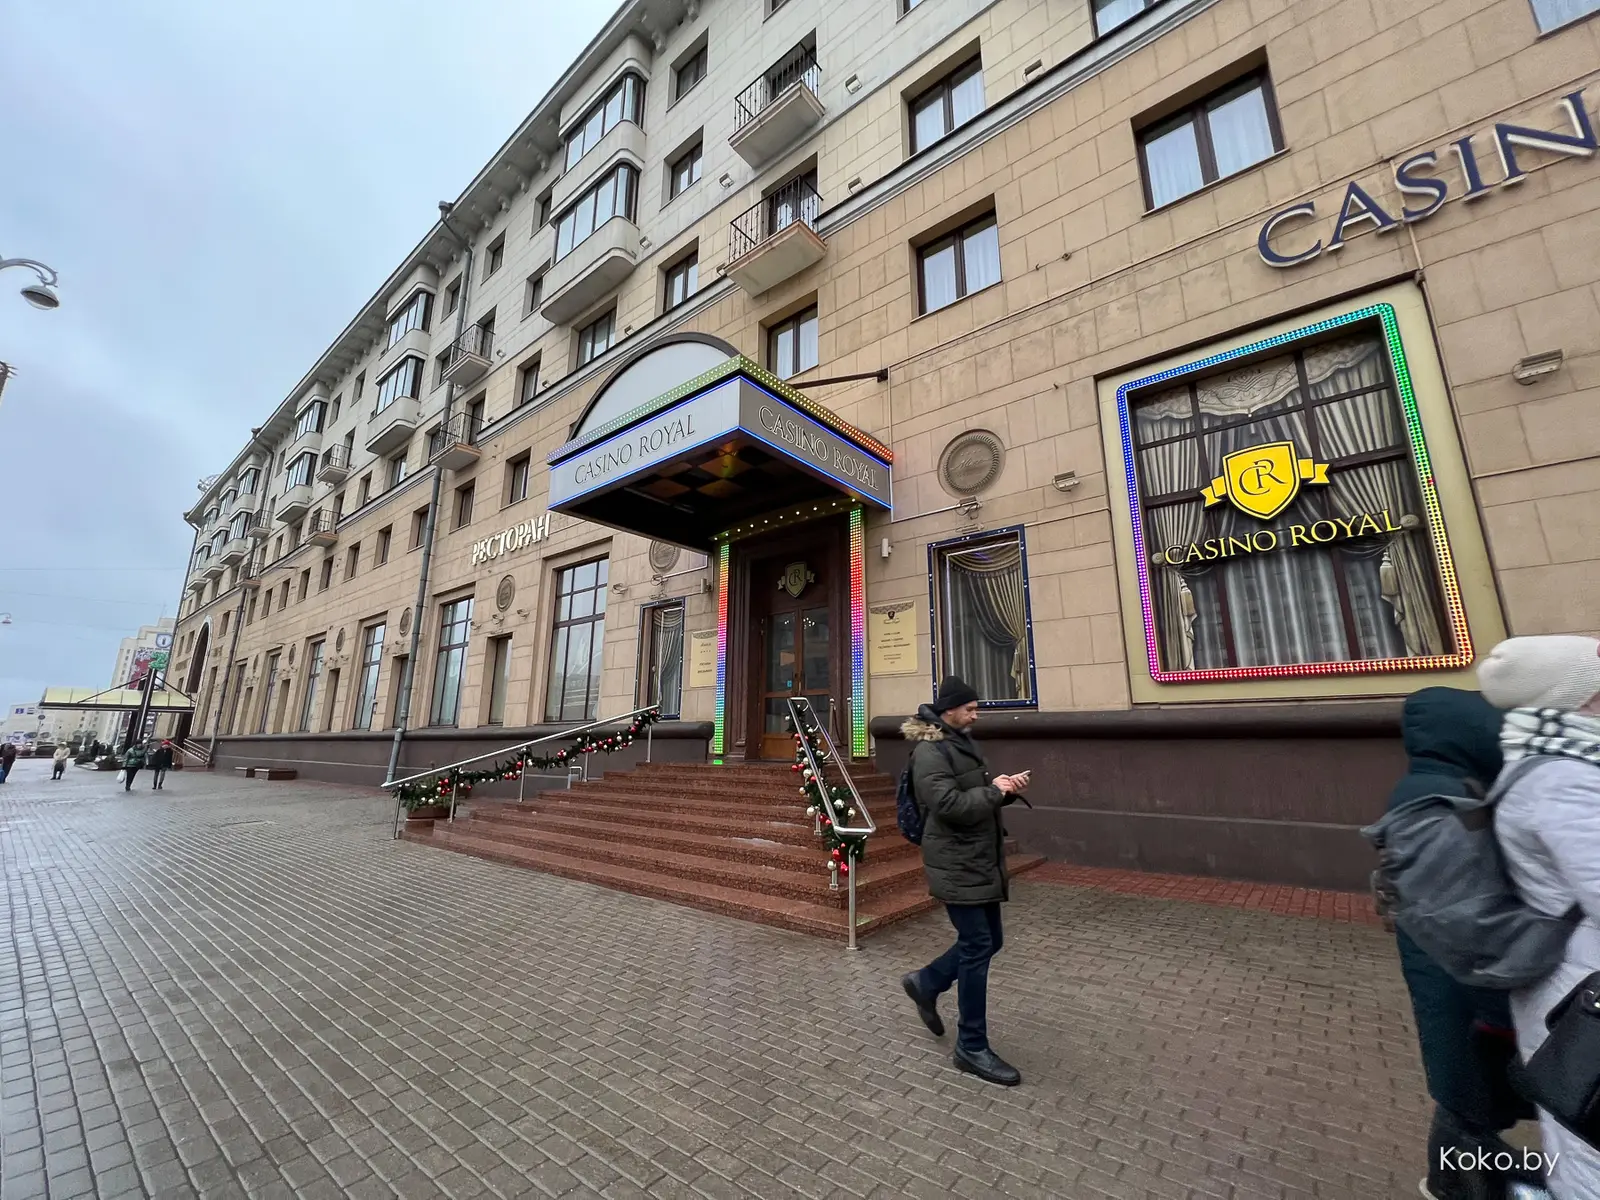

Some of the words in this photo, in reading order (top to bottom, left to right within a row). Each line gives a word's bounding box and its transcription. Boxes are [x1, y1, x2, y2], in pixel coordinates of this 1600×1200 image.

[1258, 88, 1598, 267] CASIN
[574, 443, 632, 484] CASINO
[639, 414, 695, 451] ROYAL
[759, 405, 829, 461] CASINO
[833, 447, 878, 491] ROYAL
[471, 513, 551, 566] РЕСТОРАН
[1165, 530, 1277, 565] CASINO
[1289, 509, 1401, 547] ROYAL
